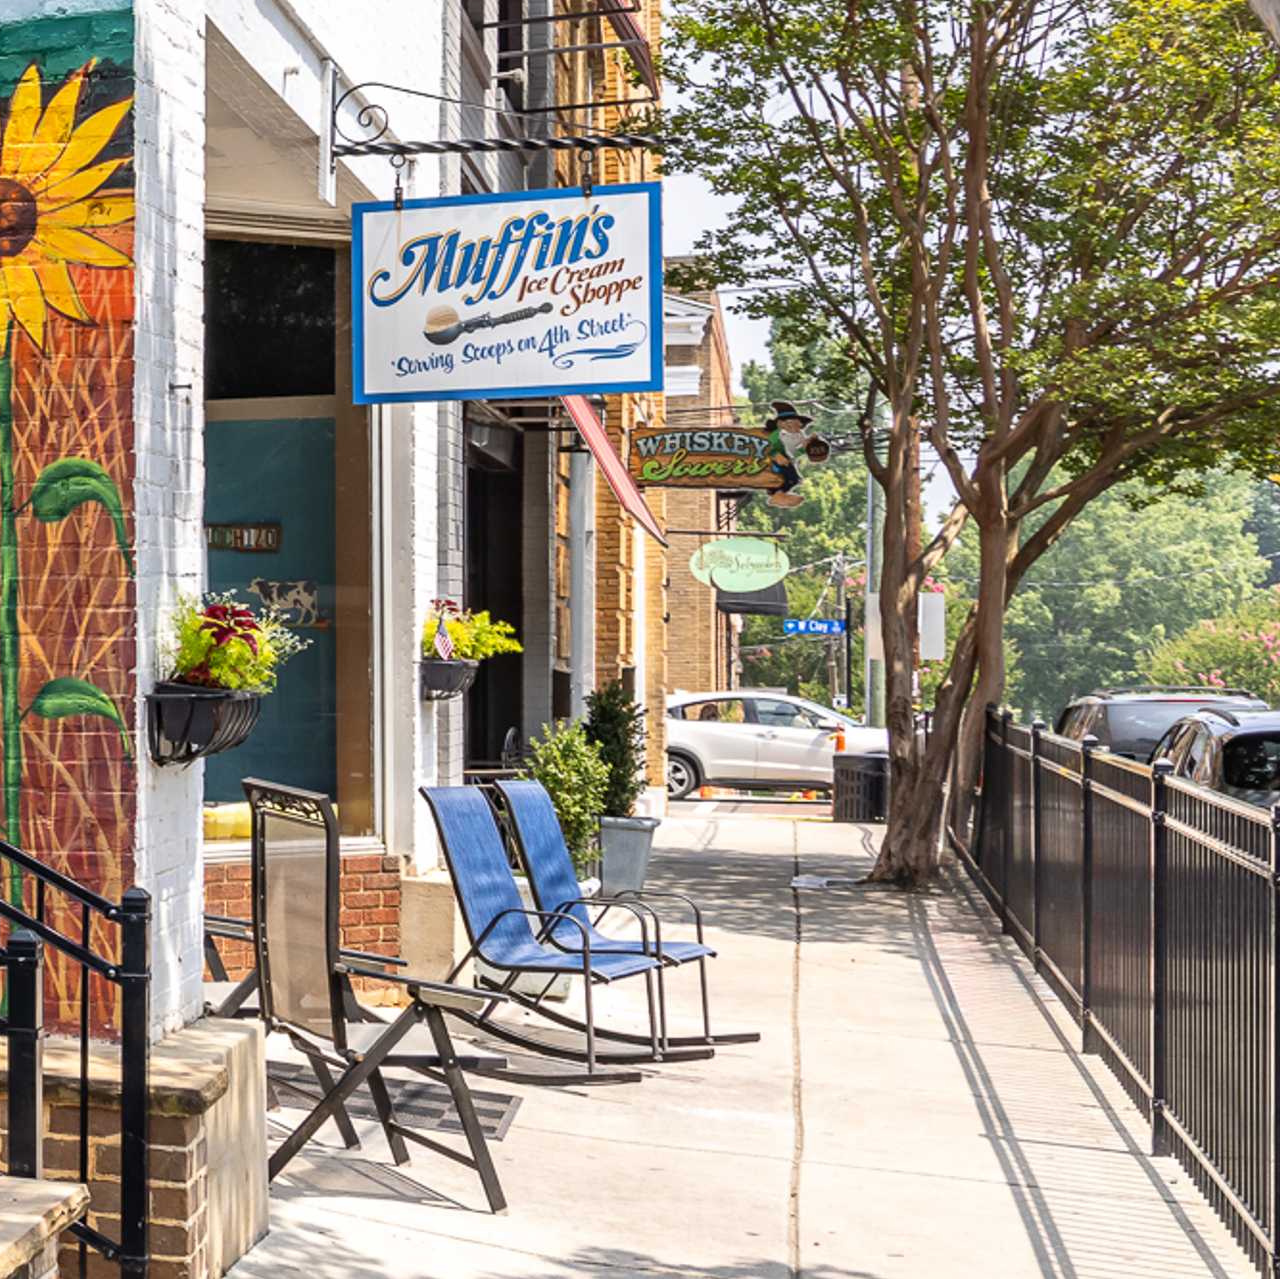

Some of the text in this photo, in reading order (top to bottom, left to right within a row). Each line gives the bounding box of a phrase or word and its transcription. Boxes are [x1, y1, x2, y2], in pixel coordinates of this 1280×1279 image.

[368, 204, 615, 307] Muffin's
[517, 258, 626, 303] Ice Cream
[560, 273, 644, 317] Shoppe
[461, 339, 514, 365] Scoops
[517, 336, 536, 352] on
[537, 325, 570, 358] 4th
[637, 430, 769, 459] WHISKEY
[809, 621, 828, 633] Clay
